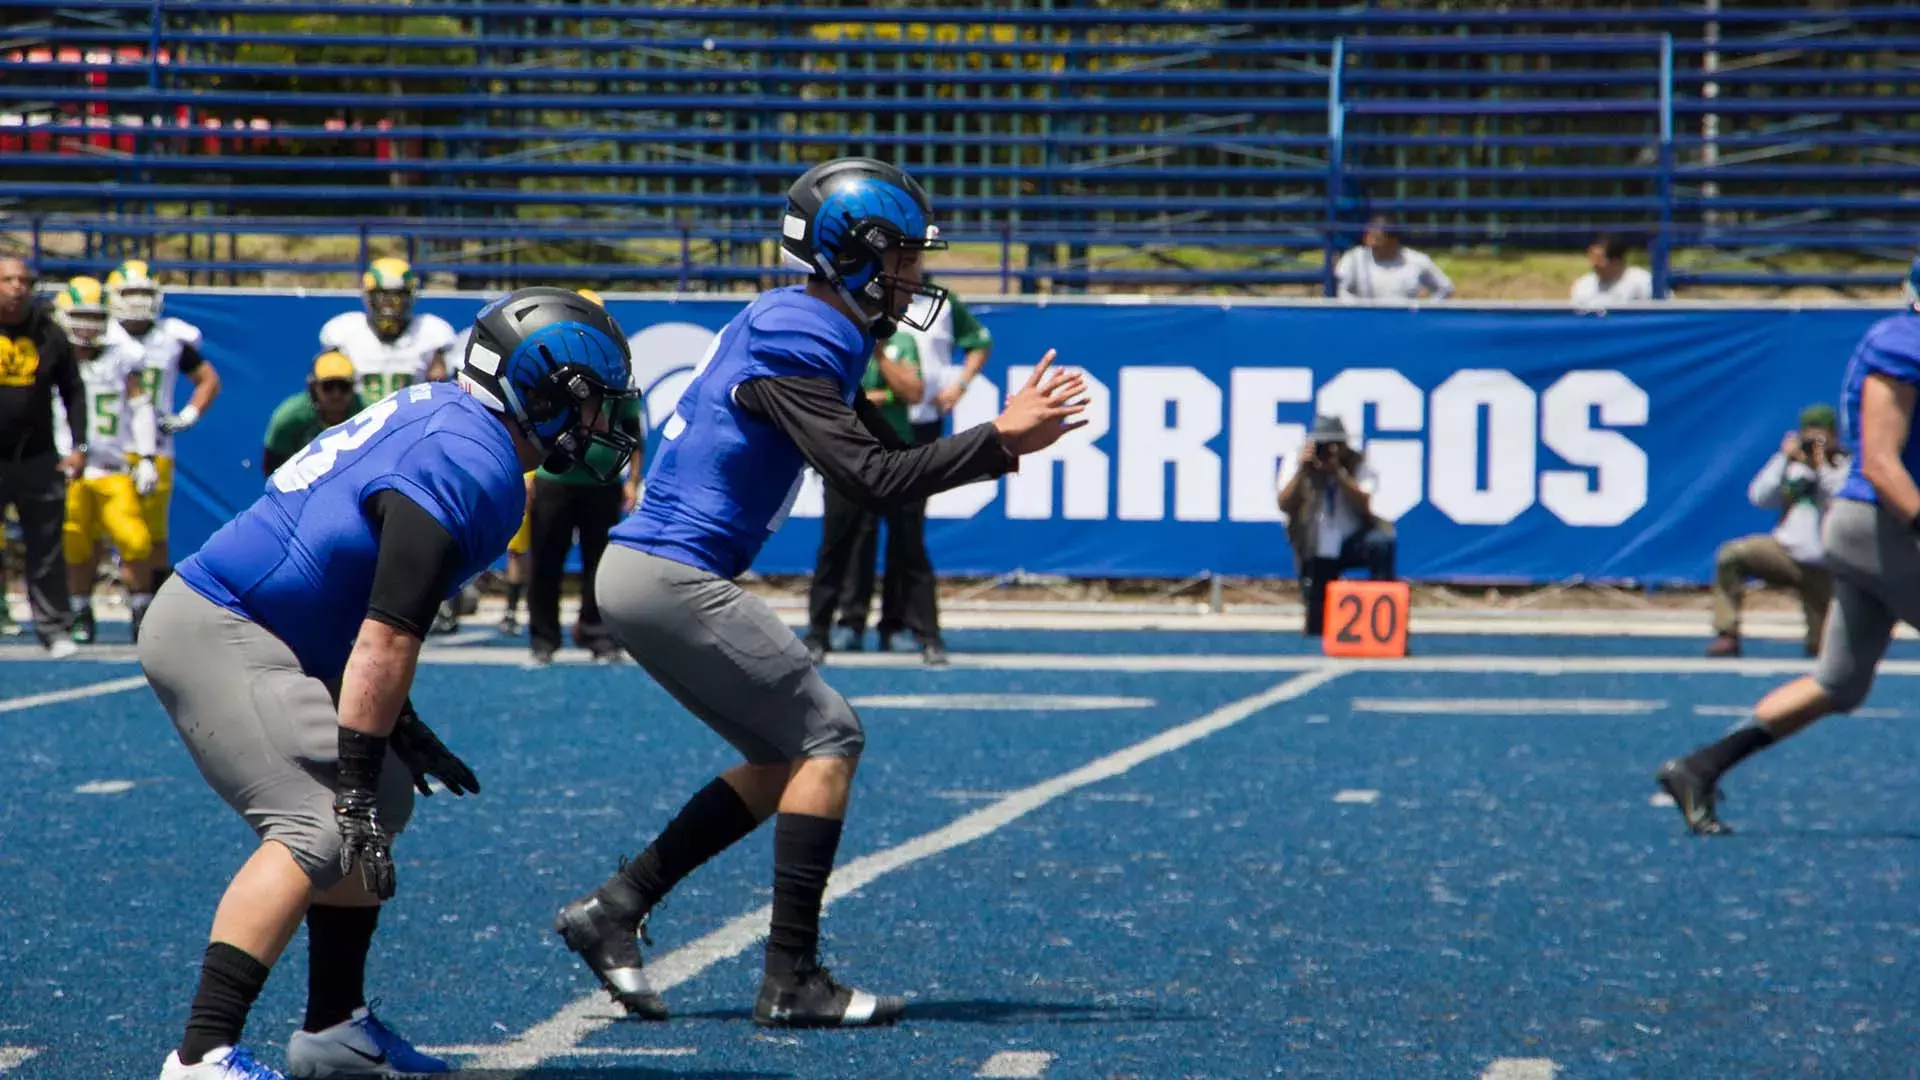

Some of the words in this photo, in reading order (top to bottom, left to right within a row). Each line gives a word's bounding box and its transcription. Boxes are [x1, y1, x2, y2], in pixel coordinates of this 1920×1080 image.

[95, 393, 118, 436] 5
[788, 364, 1649, 527] RREGOS
[1336, 594, 1397, 644] 20
